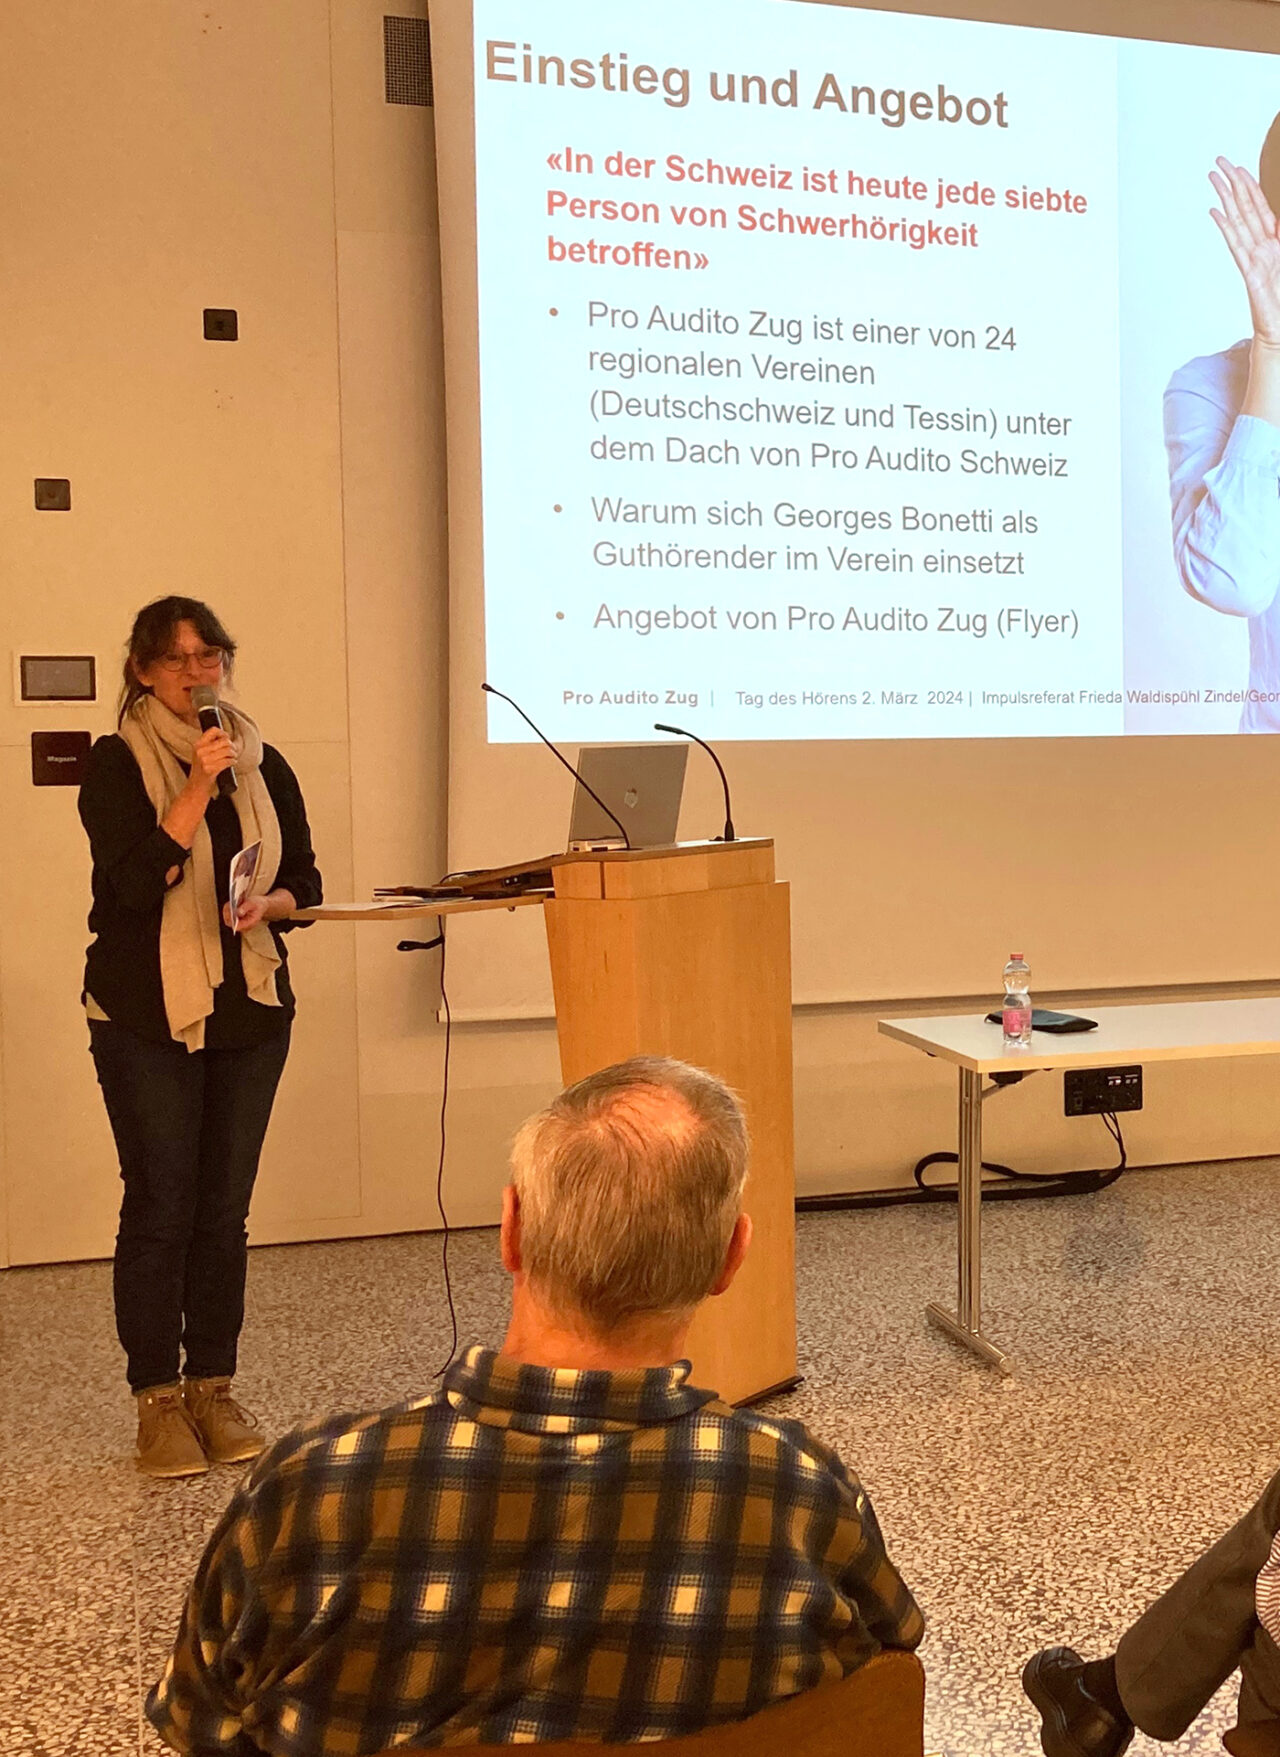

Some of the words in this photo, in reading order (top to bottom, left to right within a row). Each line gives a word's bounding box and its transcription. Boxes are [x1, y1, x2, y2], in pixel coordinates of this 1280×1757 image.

[486, 40, 690, 108] Einstieg
[709, 69, 798, 108] und
[813, 73, 1008, 128] Angebot
[547, 147, 593, 176] «In
[605, 151, 656, 179] der
[666, 154, 793, 190] Schweiz
[803, 166, 839, 193] ist
[848, 170, 927, 200] heute
[935, 178, 995, 209] jede
[1005, 185, 1088, 214] siebte
[548, 190, 660, 224] Person
[670, 206, 726, 229] von
[738, 204, 978, 249] Schwerhörigkeit
[548, 236, 709, 271] betroffen»
[588, 301, 638, 329] Pro
[646, 305, 739, 335] Audito
[749, 310, 802, 345] Zug
[813, 315, 845, 342] ist
[852, 318, 920, 346] einer
[927, 327, 975, 349] von
[984, 326, 1017, 352] 24
[589, 347, 742, 380] regionalen
[751, 353, 875, 386] Vereinen
[590, 390, 836, 427] (Deutschschweiz
[845, 403, 895, 429] und
[902, 403, 998, 440] Tessin)
[1006, 412, 1073, 437] unter
[590, 434, 655, 462] dem
[665, 437, 740, 466] Dach
[748, 446, 801, 468] von
[811, 443, 859, 470] Pro
[865, 445, 951, 473] Audito
[960, 449, 1069, 478] Schweiz
[591, 497, 697, 526] Warum
[706, 499, 763, 527] sich
[773, 502, 893, 537] Georges
[901, 506, 993, 534] Bonetti
[1001, 509, 1039, 534] als
[593, 541, 778, 571] Guthörender
[785, 545, 818, 571] im
[826, 546, 914, 573] Verein
[922, 549, 1025, 575] einsetzt
[593, 604, 718, 636] Angebot
[726, 610, 777, 631] von
[787, 606, 836, 631] Pro
[842, 606, 929, 632] Audito
[936, 608, 988, 639] Zug
[996, 608, 1079, 640] (Flyer)
[563, 690, 595, 706] Pro
[599, 690, 660, 706] Audito
[664, 690, 699, 708] Zug
[735, 691, 764, 709] Tag
[768, 691, 798, 706] des
[802, 691, 858, 706] Hörens
[861, 691, 876, 706] 2.
[881, 691, 918, 706] März
[926, 691, 964, 706] 2024
[981, 690, 1076, 707] Impulsreferat
[1079, 690, 1123, 705] Frieda
[1127, 689, 1200, 707] Waldispühl
